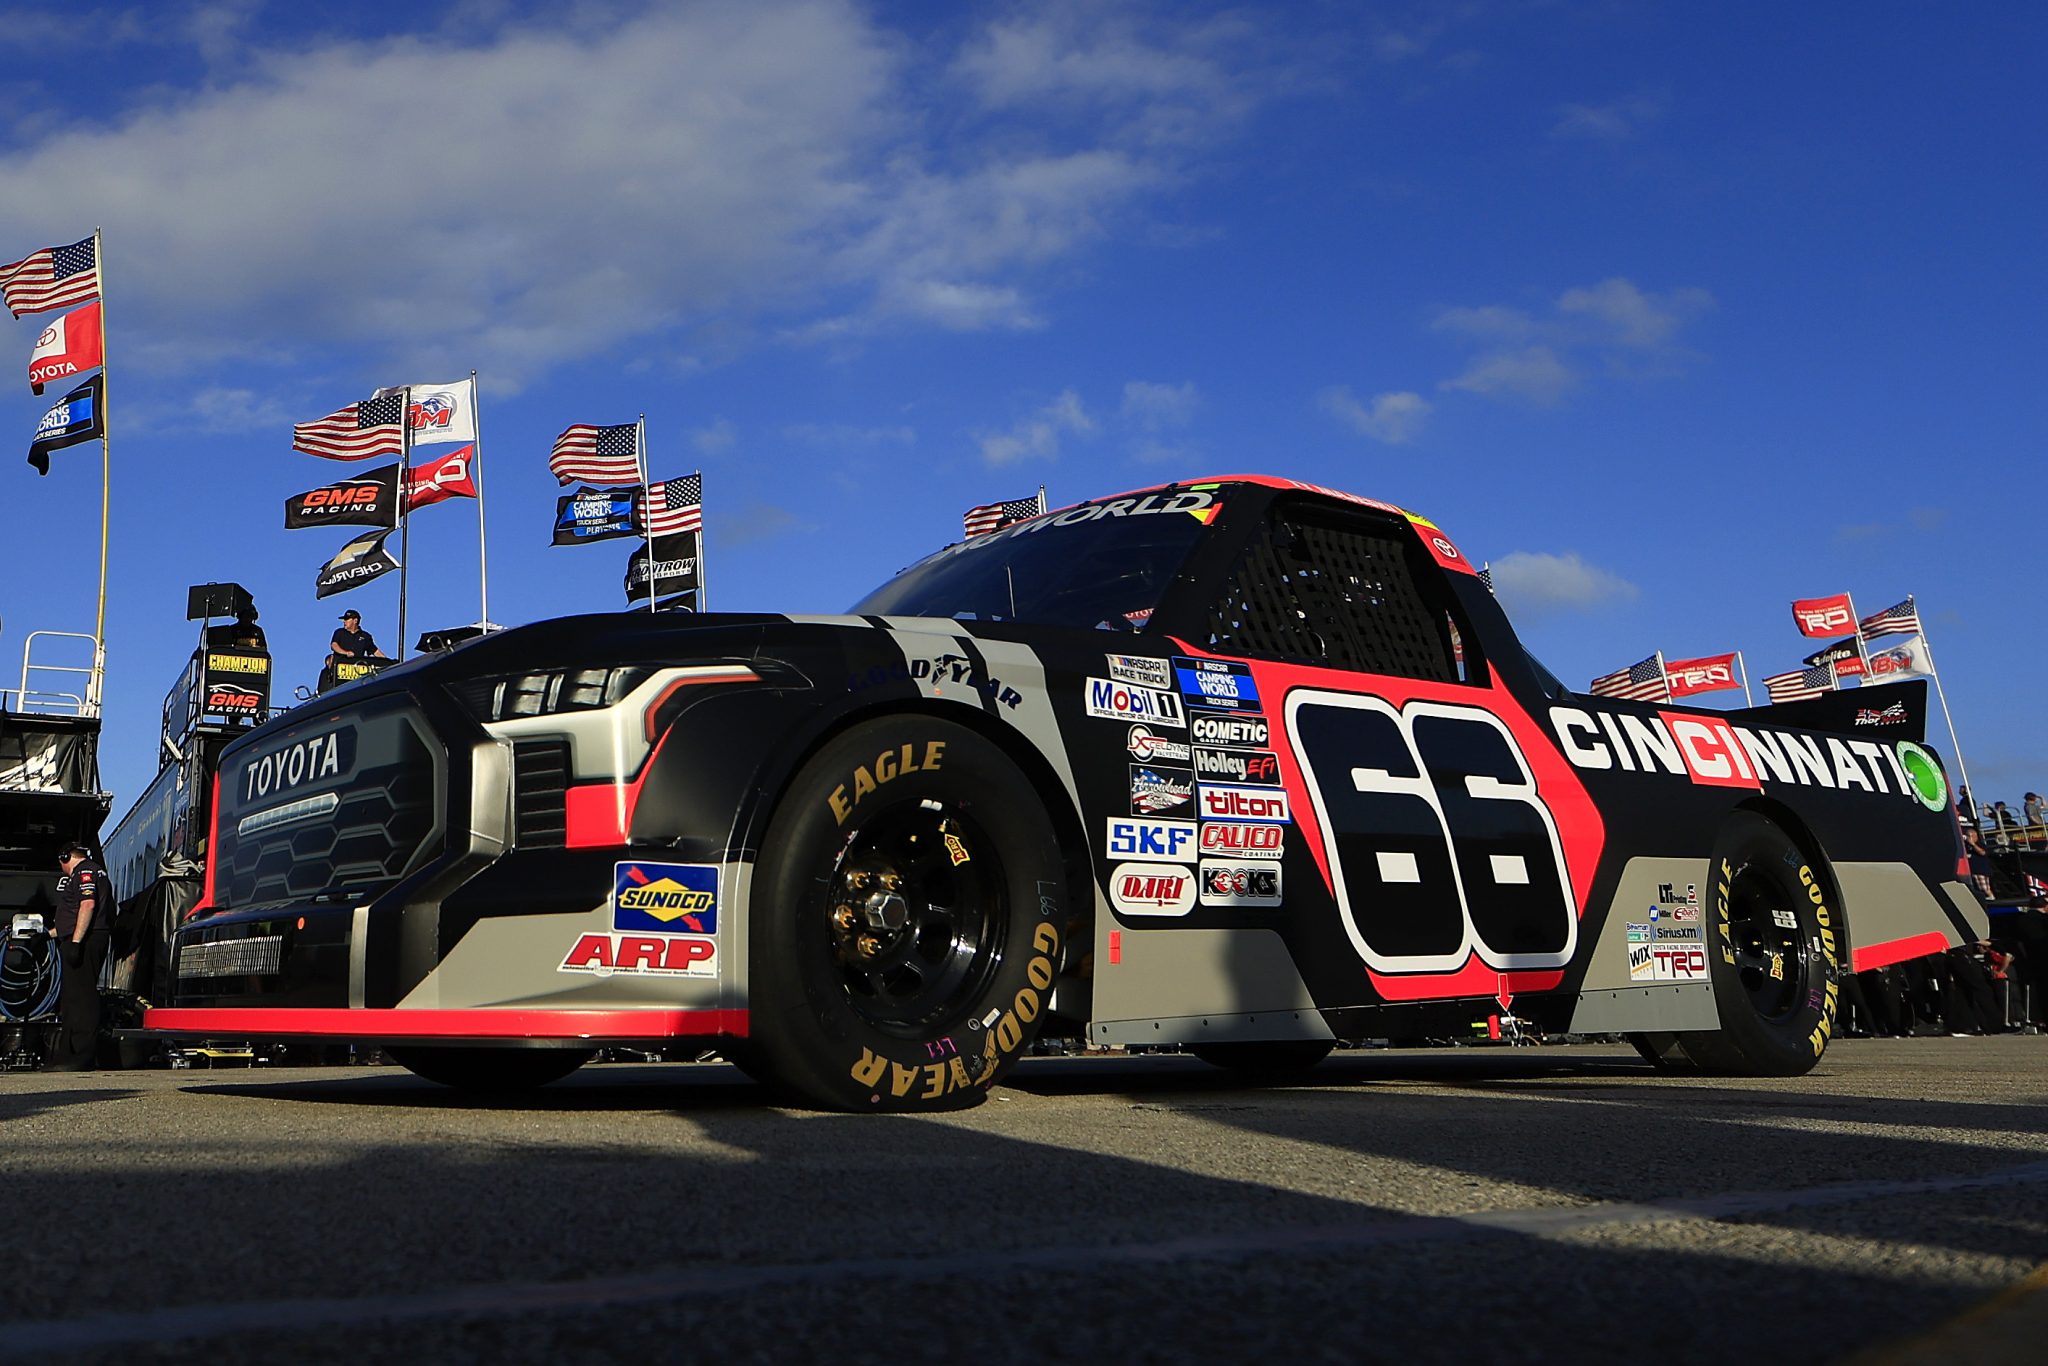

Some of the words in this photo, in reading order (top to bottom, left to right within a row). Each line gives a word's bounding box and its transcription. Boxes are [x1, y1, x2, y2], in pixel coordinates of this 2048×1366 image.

[37, 415, 71, 433] ORLD
[303, 486, 379, 507] GMS
[573, 500, 612, 510] CAMPING
[301, 503, 377, 516] RACING
[574, 508, 612, 519] WORLD
[1010, 492, 1216, 538] WORLD
[209, 654, 268, 671] CHAMPION
[1125, 657, 1162, 672] NASCAR
[1203, 661, 1228, 672] NASCAR
[1113, 666, 1135, 680] RACE
[1136, 671, 1166, 684] TRUCK
[1196, 672, 1236, 686] CAMPING
[1667, 667, 1730, 688] TRD
[209, 693, 259, 707] GMS
[1092, 680, 1155, 716] Mobil
[1161, 695, 1173, 717] 1
[1199, 681, 1239, 697] WORLD
[208, 705, 258, 714] RACING
[1193, 719, 1268, 742] COMETIC
[1549, 706, 1912, 796] CINCINNATI
[247, 732, 338, 801] TOYOTA
[1195, 750, 1247, 780] Holley
[828, 741, 946, 826] EAGLE
[1205, 791, 1284, 818] tilton
[1111, 824, 1194, 855] SKF
[1202, 825, 1281, 850] CALICO
[1122, 875, 1190, 899] DART
[1202, 868, 1281, 897] KOOKS
[622, 890, 710, 909] SUNOCO
[1719, 857, 1737, 966] EAGLE
[564, 935, 715, 970] ARP
[1629, 944, 1651, 968] WIX
[1653, 951, 1705, 978] TRD
[1799, 864, 1839, 1058] GOODYEAR
[850, 922, 1059, 1100] GOODYEAR
